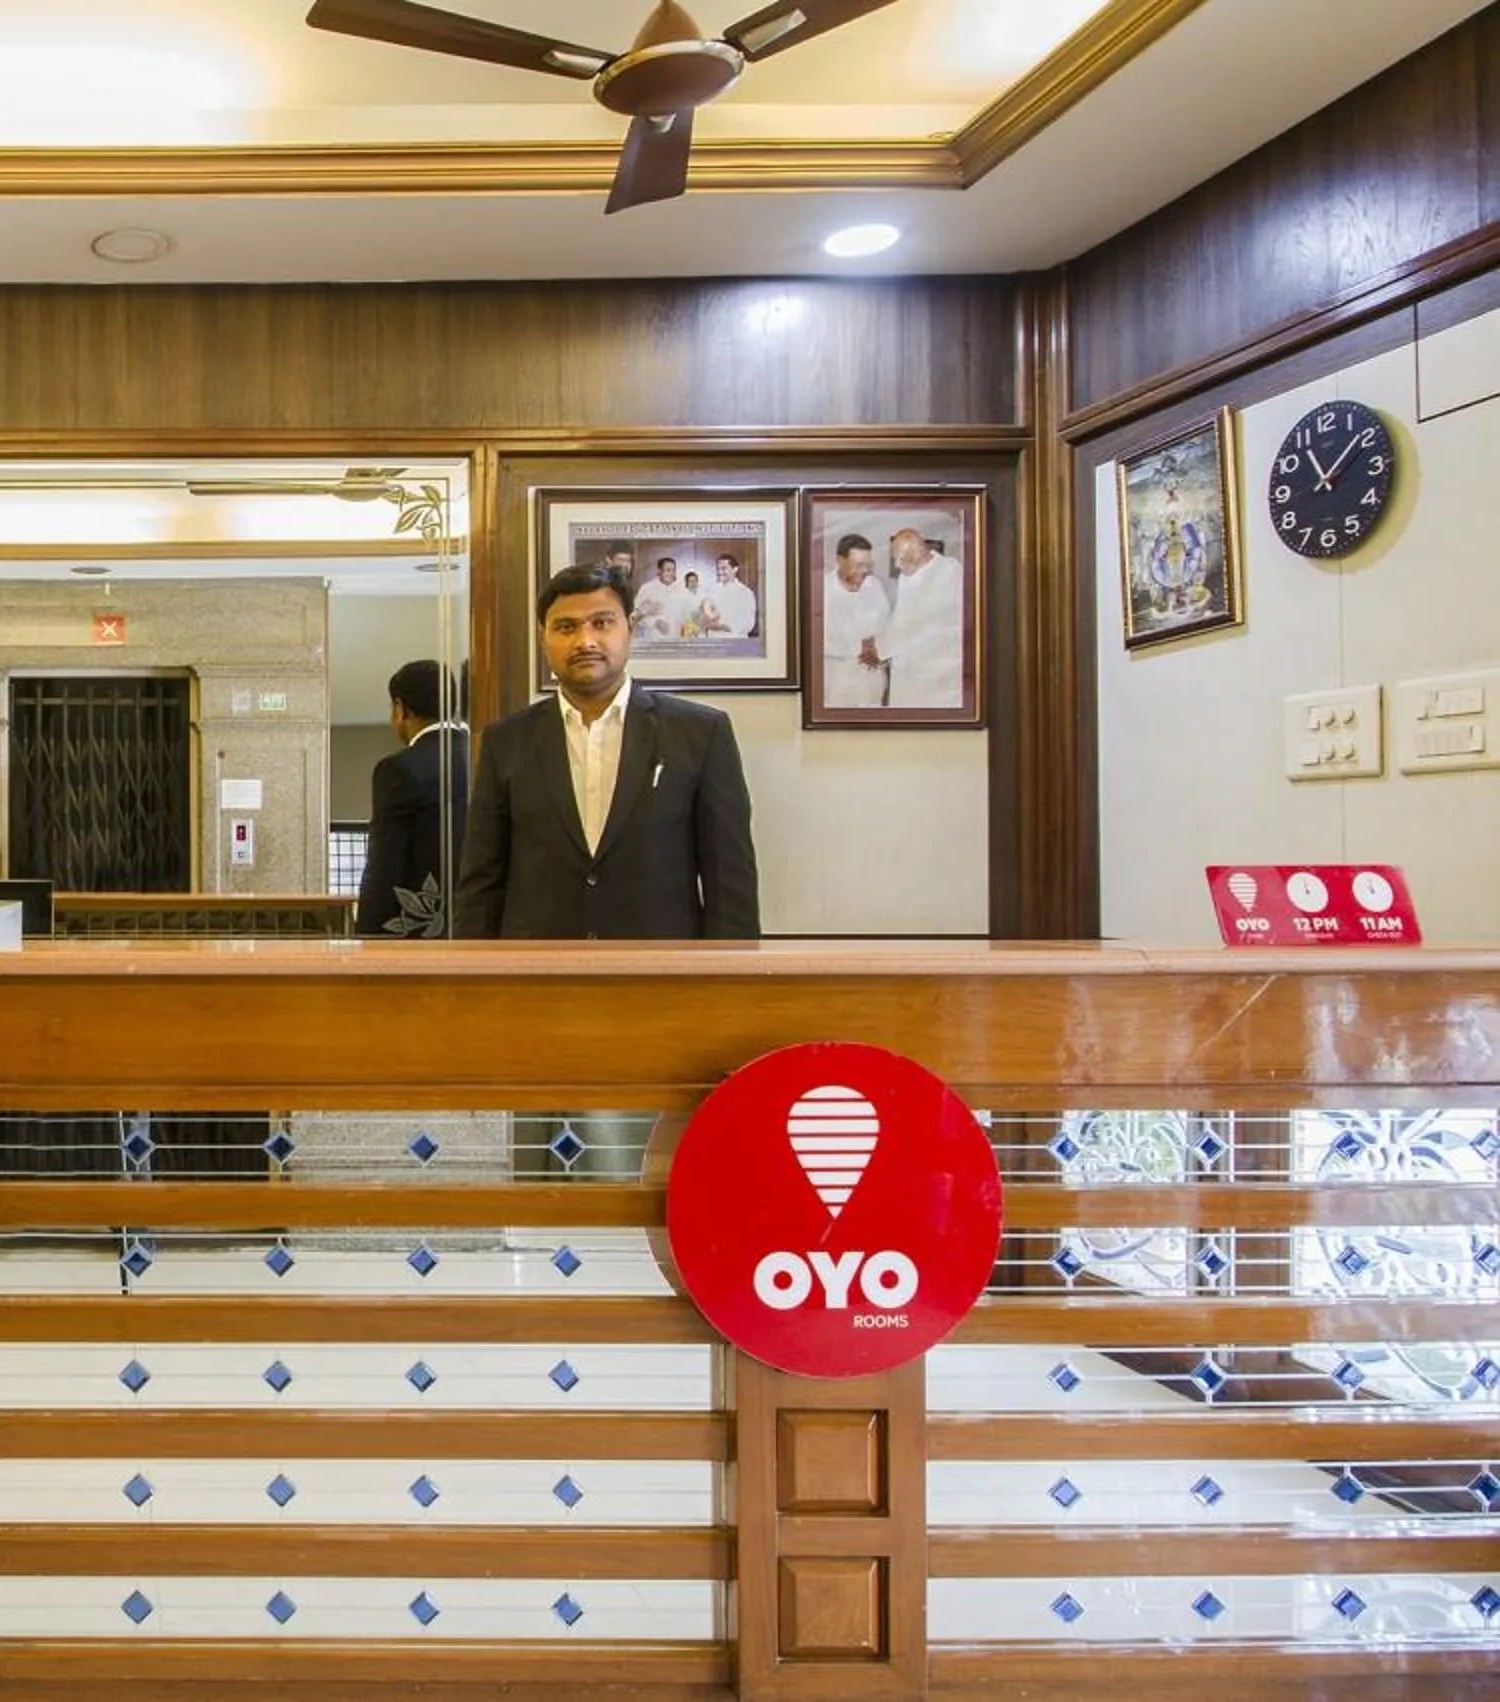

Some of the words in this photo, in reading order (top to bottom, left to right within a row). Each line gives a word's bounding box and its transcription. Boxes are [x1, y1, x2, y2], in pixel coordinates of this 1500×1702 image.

[1317, 412, 1336, 433] 12
[1347, 413, 1353, 431] 1
[1297, 428, 1311, 449] 11
[1361, 427, 1376, 447] 2
[1278, 454, 1299, 475] 10
[1367, 455, 1384, 476] 3
[1275, 485, 1291, 503] 9
[1360, 488, 1376, 505] 4
[1281, 511, 1296, 529] 8
[1344, 515, 1360, 534] 5
[1299, 527, 1313, 549] 7
[1319, 529, 1337, 548] 6
[1236, 918, 1270, 931] OYO
[1293, 917, 1312, 931] 12
[1314, 917, 1339, 931] PM
[1360, 917, 1375, 931] 11
[1377, 917, 1403, 931] AM
[753, 1250, 919, 1310] OYO
[853, 1315, 909, 1329] ROOMS
